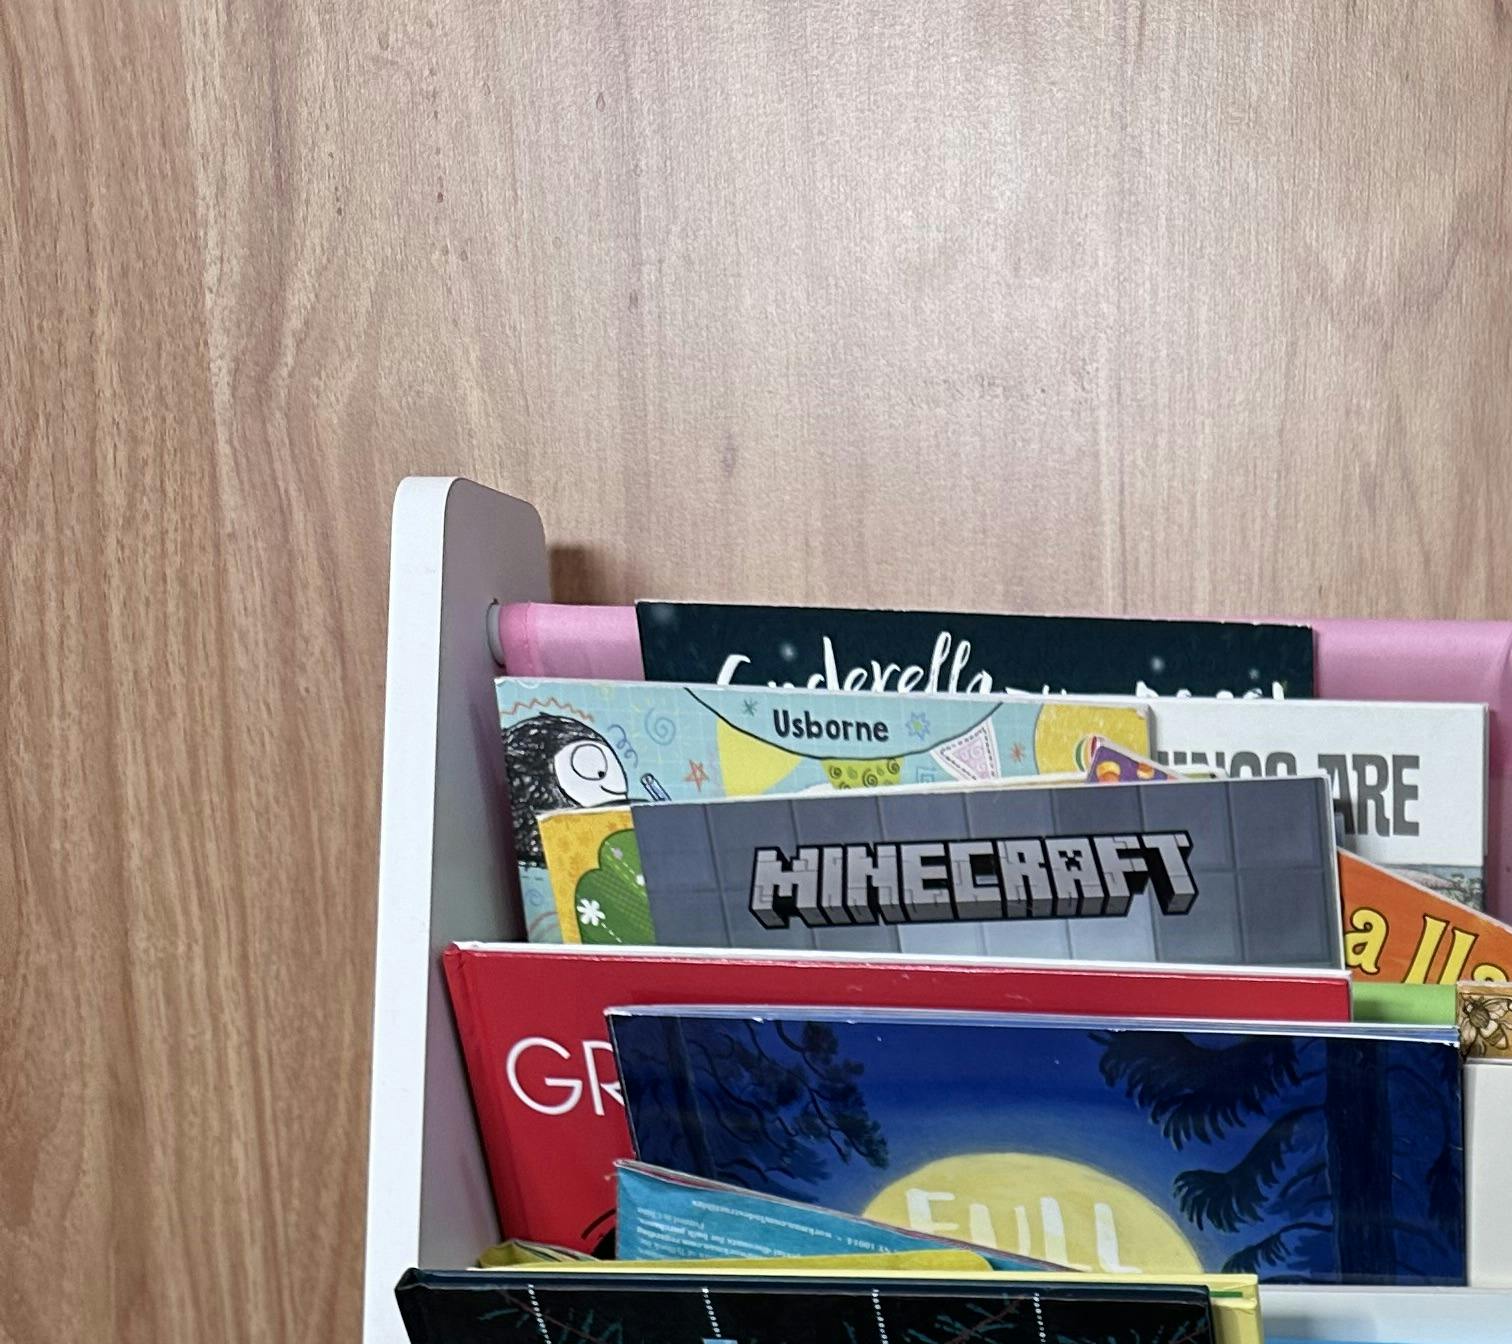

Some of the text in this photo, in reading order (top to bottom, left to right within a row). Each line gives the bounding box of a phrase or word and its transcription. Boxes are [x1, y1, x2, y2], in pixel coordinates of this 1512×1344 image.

[773, 707, 890, 743] Usborne
[1317, 753, 1421, 837] ARE
[747, 829, 1200, 930] MINECRAFT
